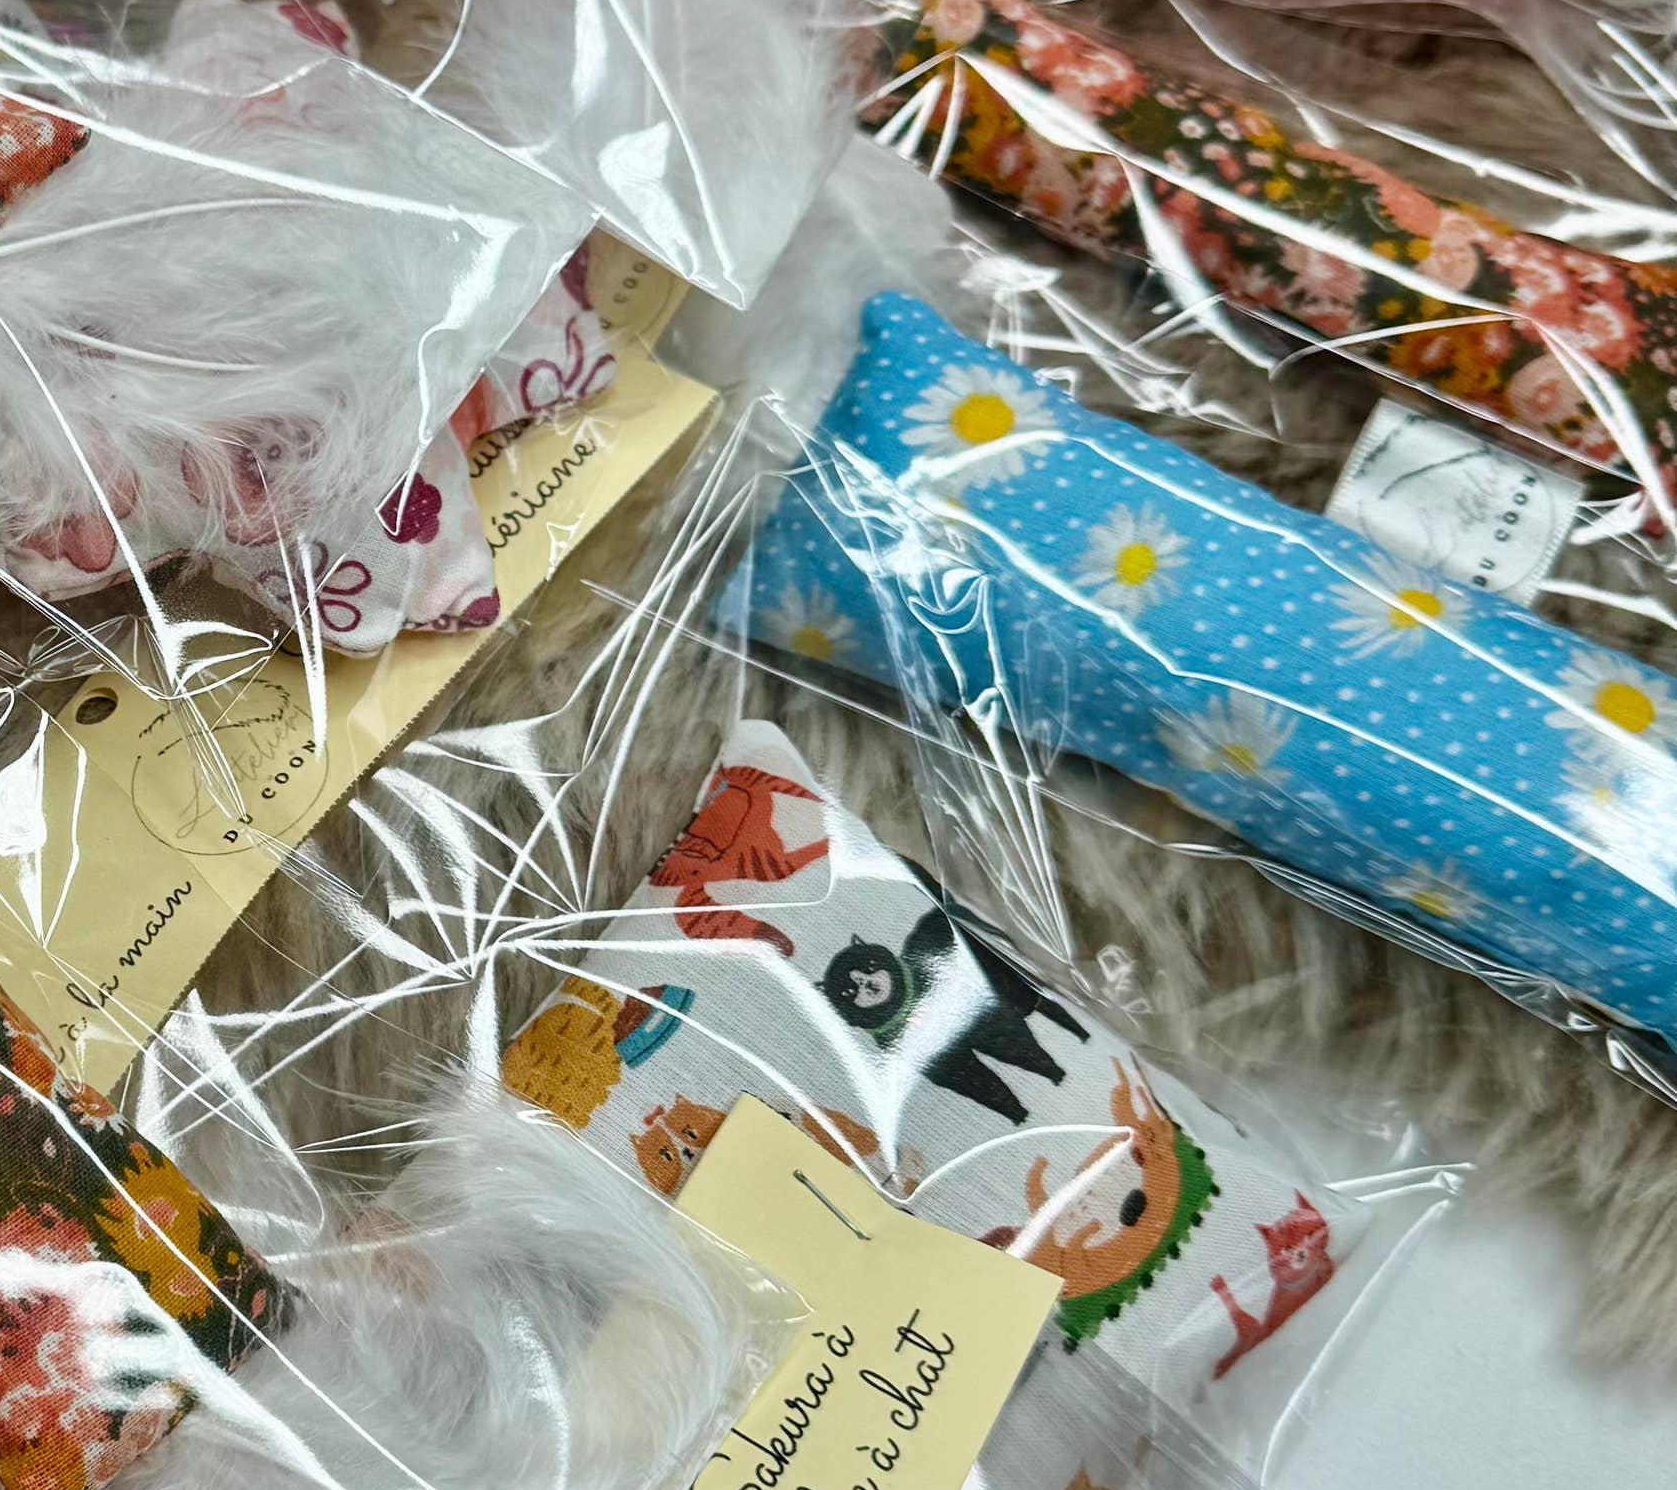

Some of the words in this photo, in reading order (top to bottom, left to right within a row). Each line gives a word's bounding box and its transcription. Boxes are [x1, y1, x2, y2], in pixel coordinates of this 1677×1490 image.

[64, 973, 121, 1011] la
[118, 879, 194, 969] main
[810, 1324, 856, 1358] à
[858, 1307, 956, 1431] chat
[855, 1437, 901, 1473] à
